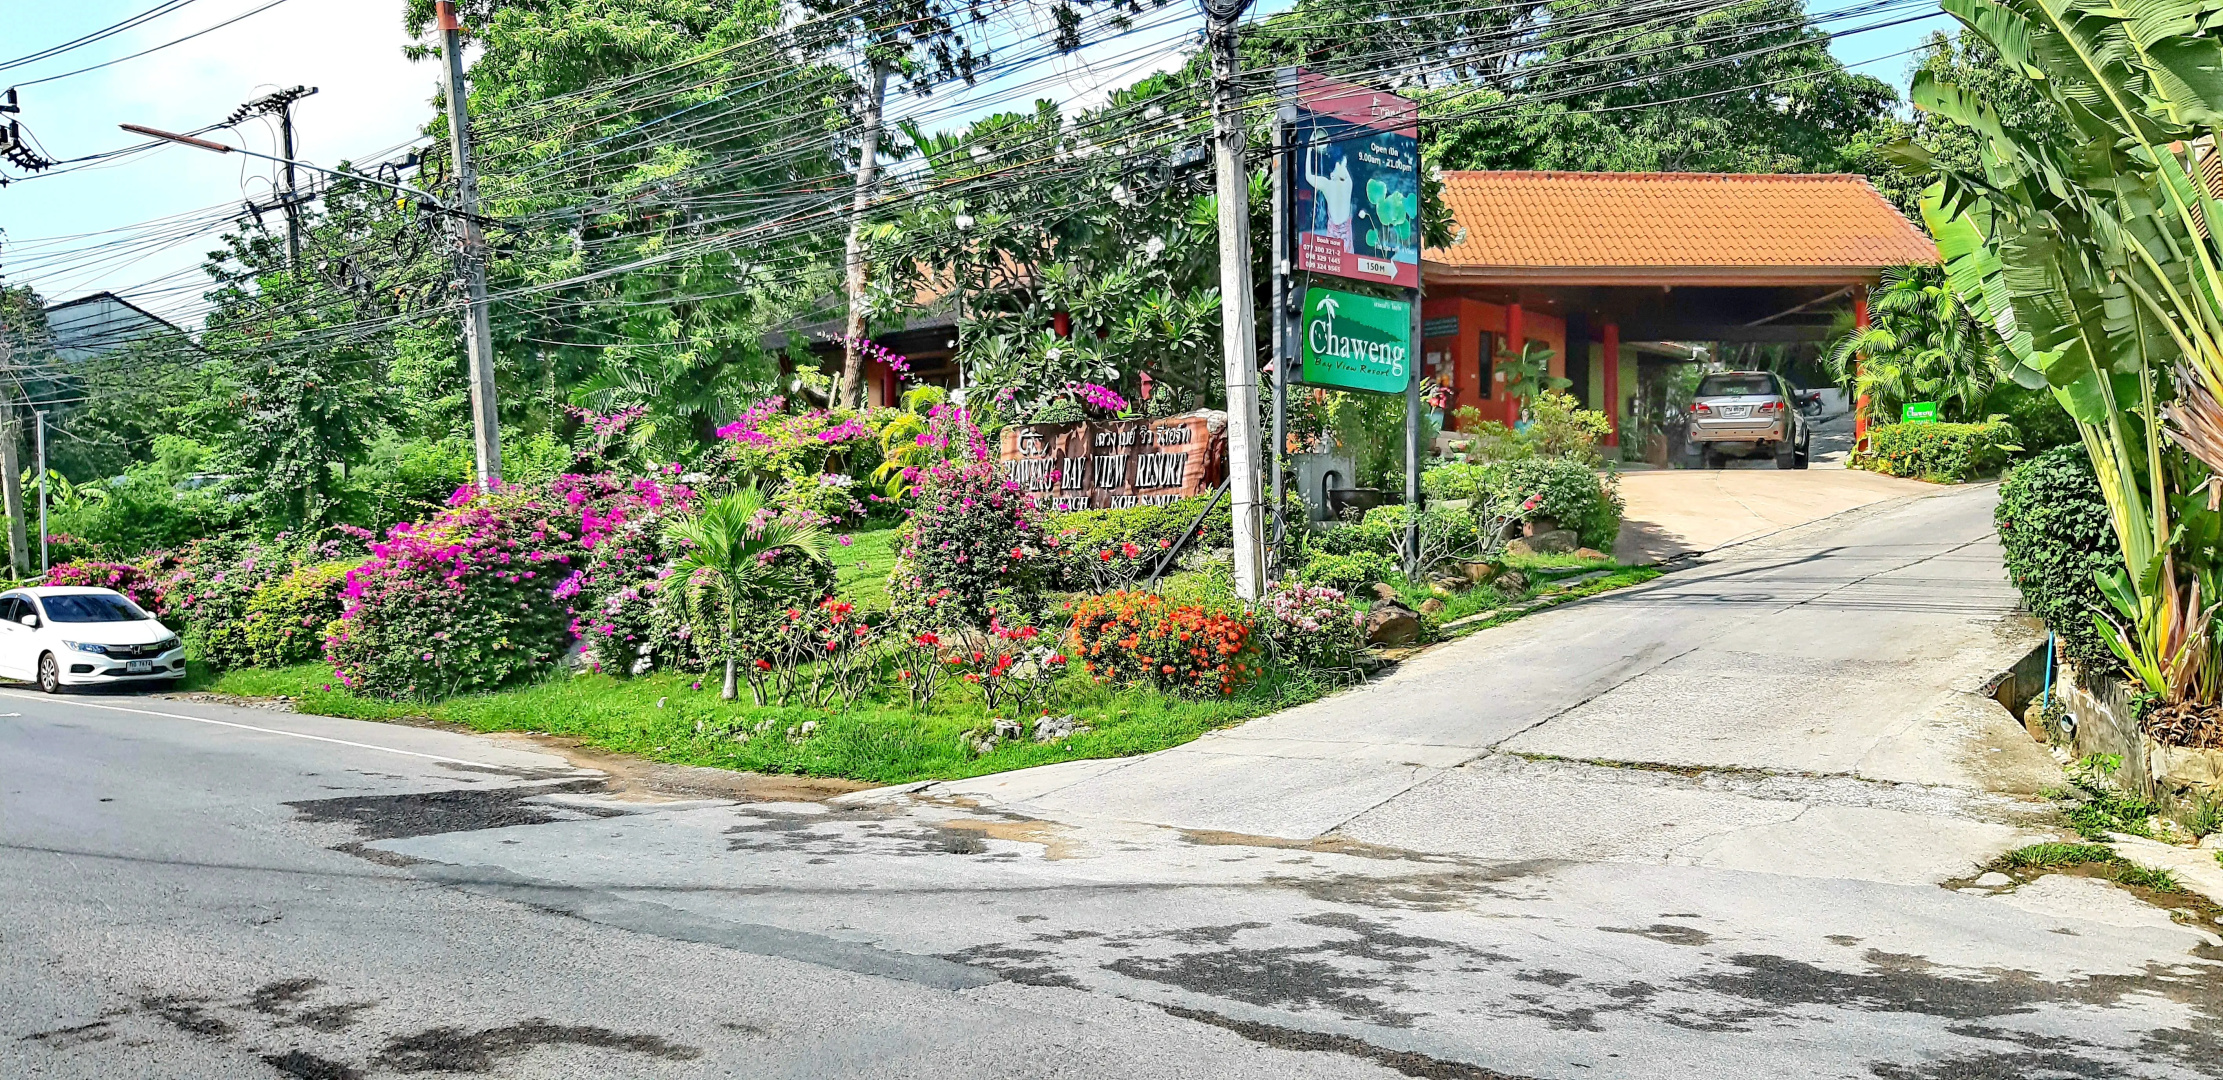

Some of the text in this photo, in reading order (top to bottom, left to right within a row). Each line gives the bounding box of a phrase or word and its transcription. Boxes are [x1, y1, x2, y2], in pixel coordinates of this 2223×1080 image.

[1371, 142, 1387, 155] Open
[1358, 151, 1381, 166] 9.00am
[1386, 158, 1412, 172] 21.00pm
[1316, 236, 1329, 245] Book
[1366, 262, 1385, 273] 150 M
[1309, 319, 1405, 377] Chaweng
[1315, 358, 1390, 377] Bay View Resort
[1061, 457, 1087, 490] BAY
[1094, 455, 1128, 488] VIEW
[1135, 452, 1187, 487] RESORT
[1110, 495, 1137, 510] KOH
